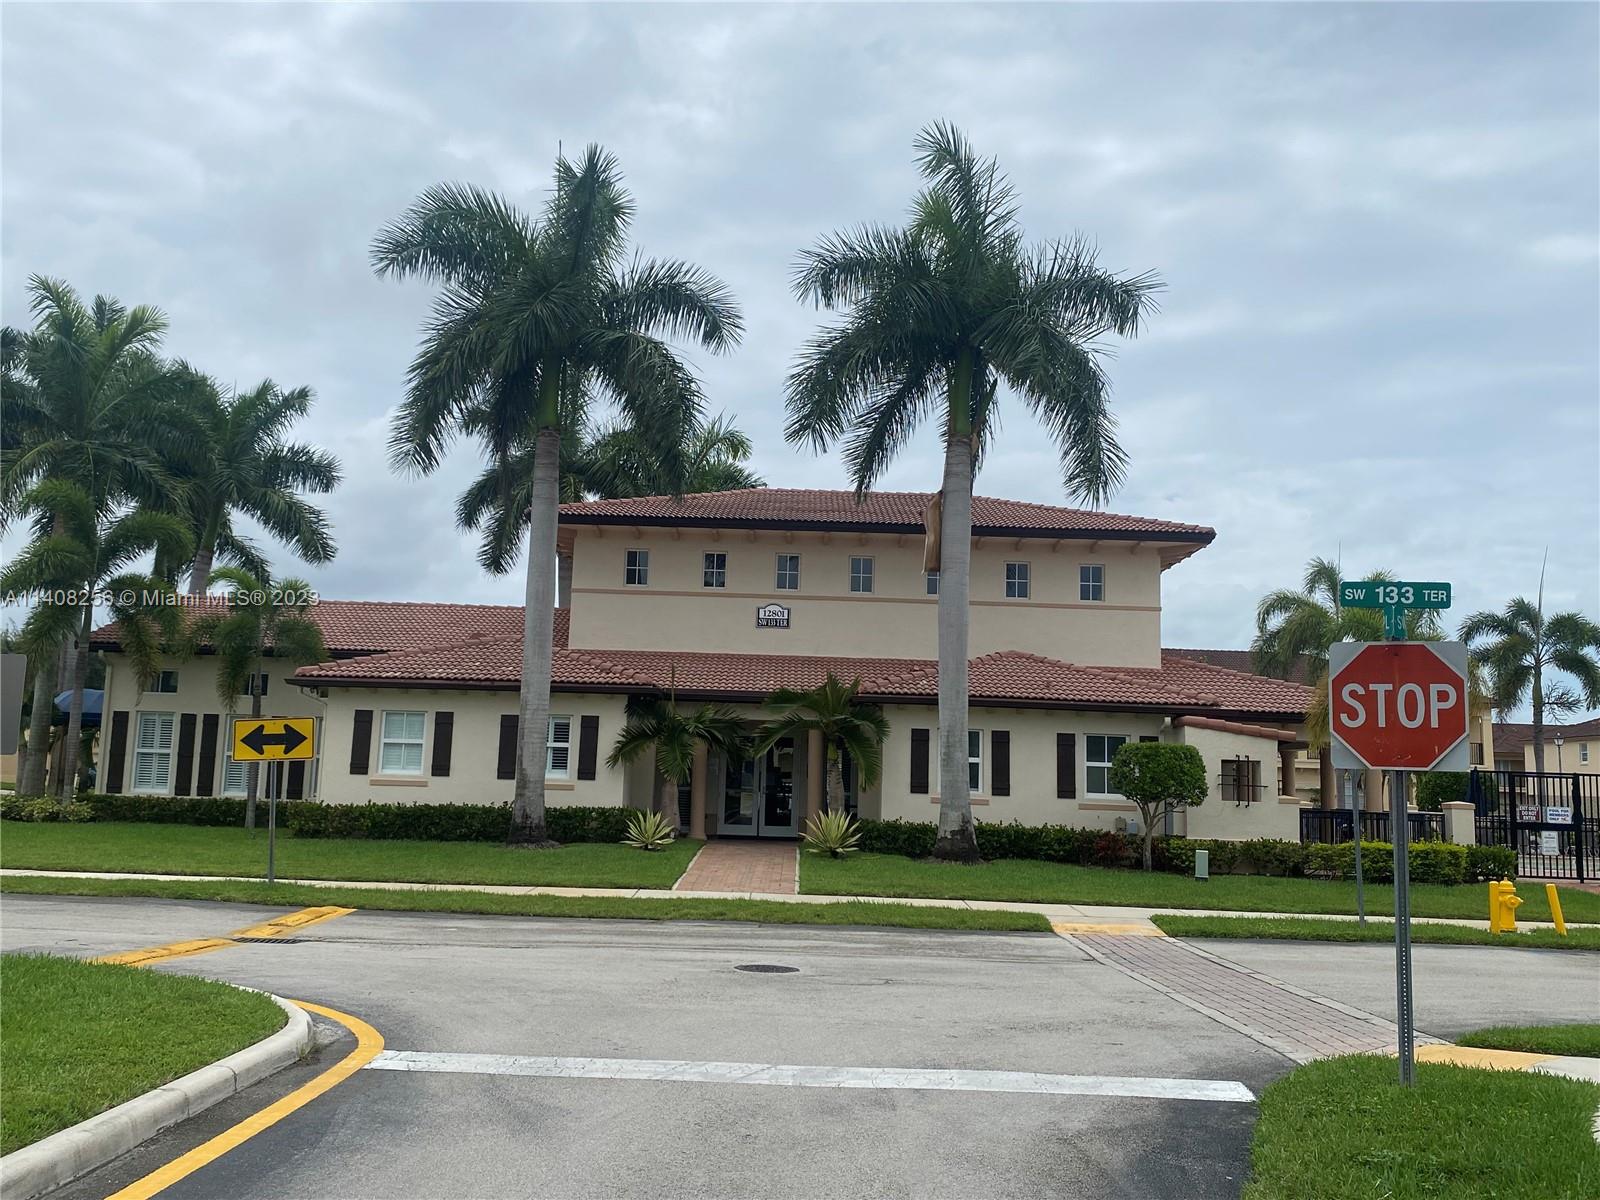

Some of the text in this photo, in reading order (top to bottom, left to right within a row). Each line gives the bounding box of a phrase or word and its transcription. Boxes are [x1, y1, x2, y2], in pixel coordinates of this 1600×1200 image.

[1345, 586, 1447, 604] SW 133 TER
[1340, 683, 1457, 729] STOP
